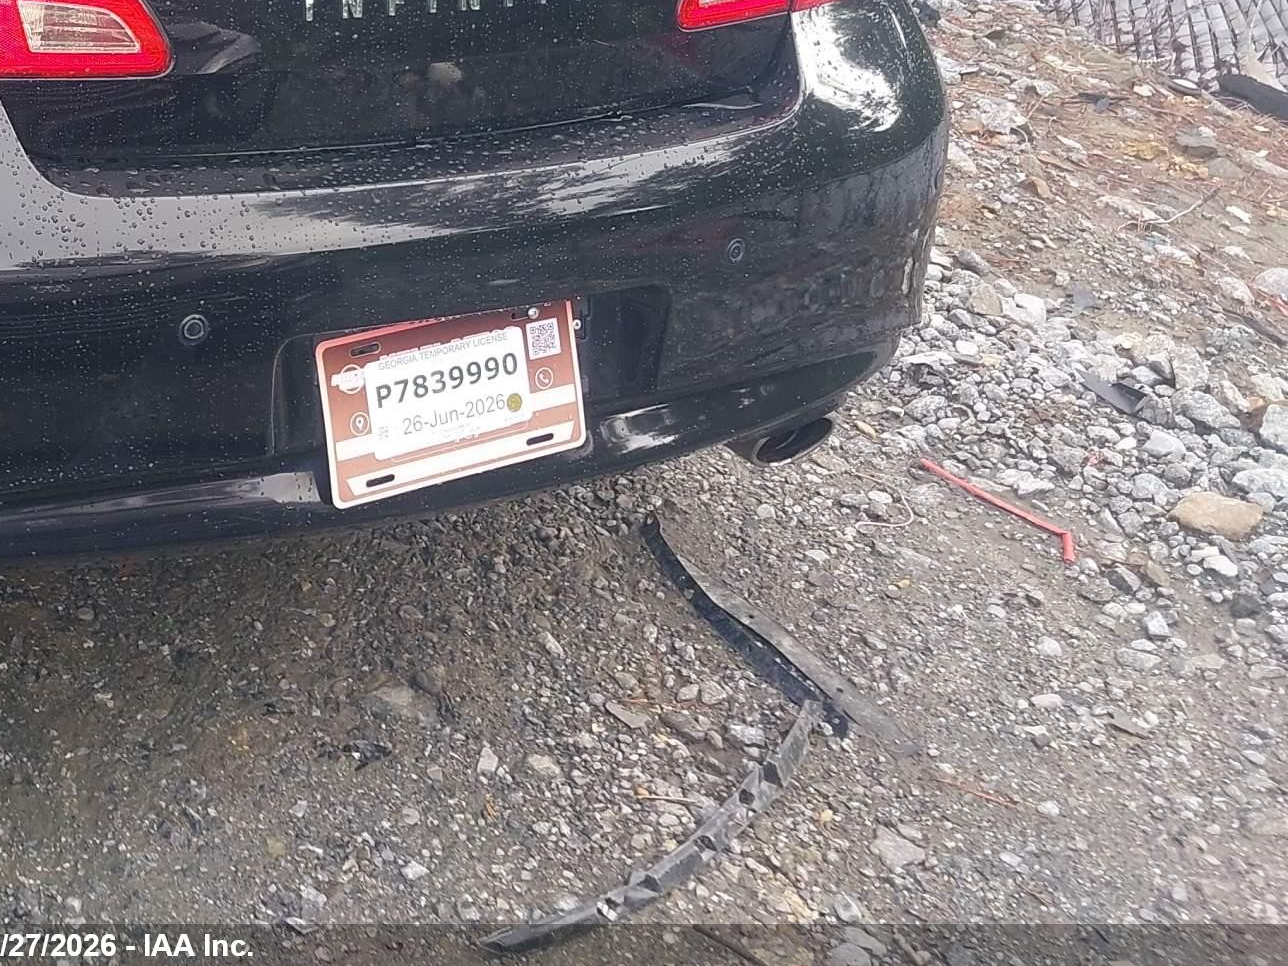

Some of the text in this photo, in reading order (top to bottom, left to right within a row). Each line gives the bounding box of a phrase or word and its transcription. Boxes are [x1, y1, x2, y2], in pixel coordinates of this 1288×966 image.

[378, 331, 508, 371] GEORGIA TEMPORARY LICENSE
[375, 352, 518, 409] P7839990
[402, 394, 505, 436] 26-Jun-2026
